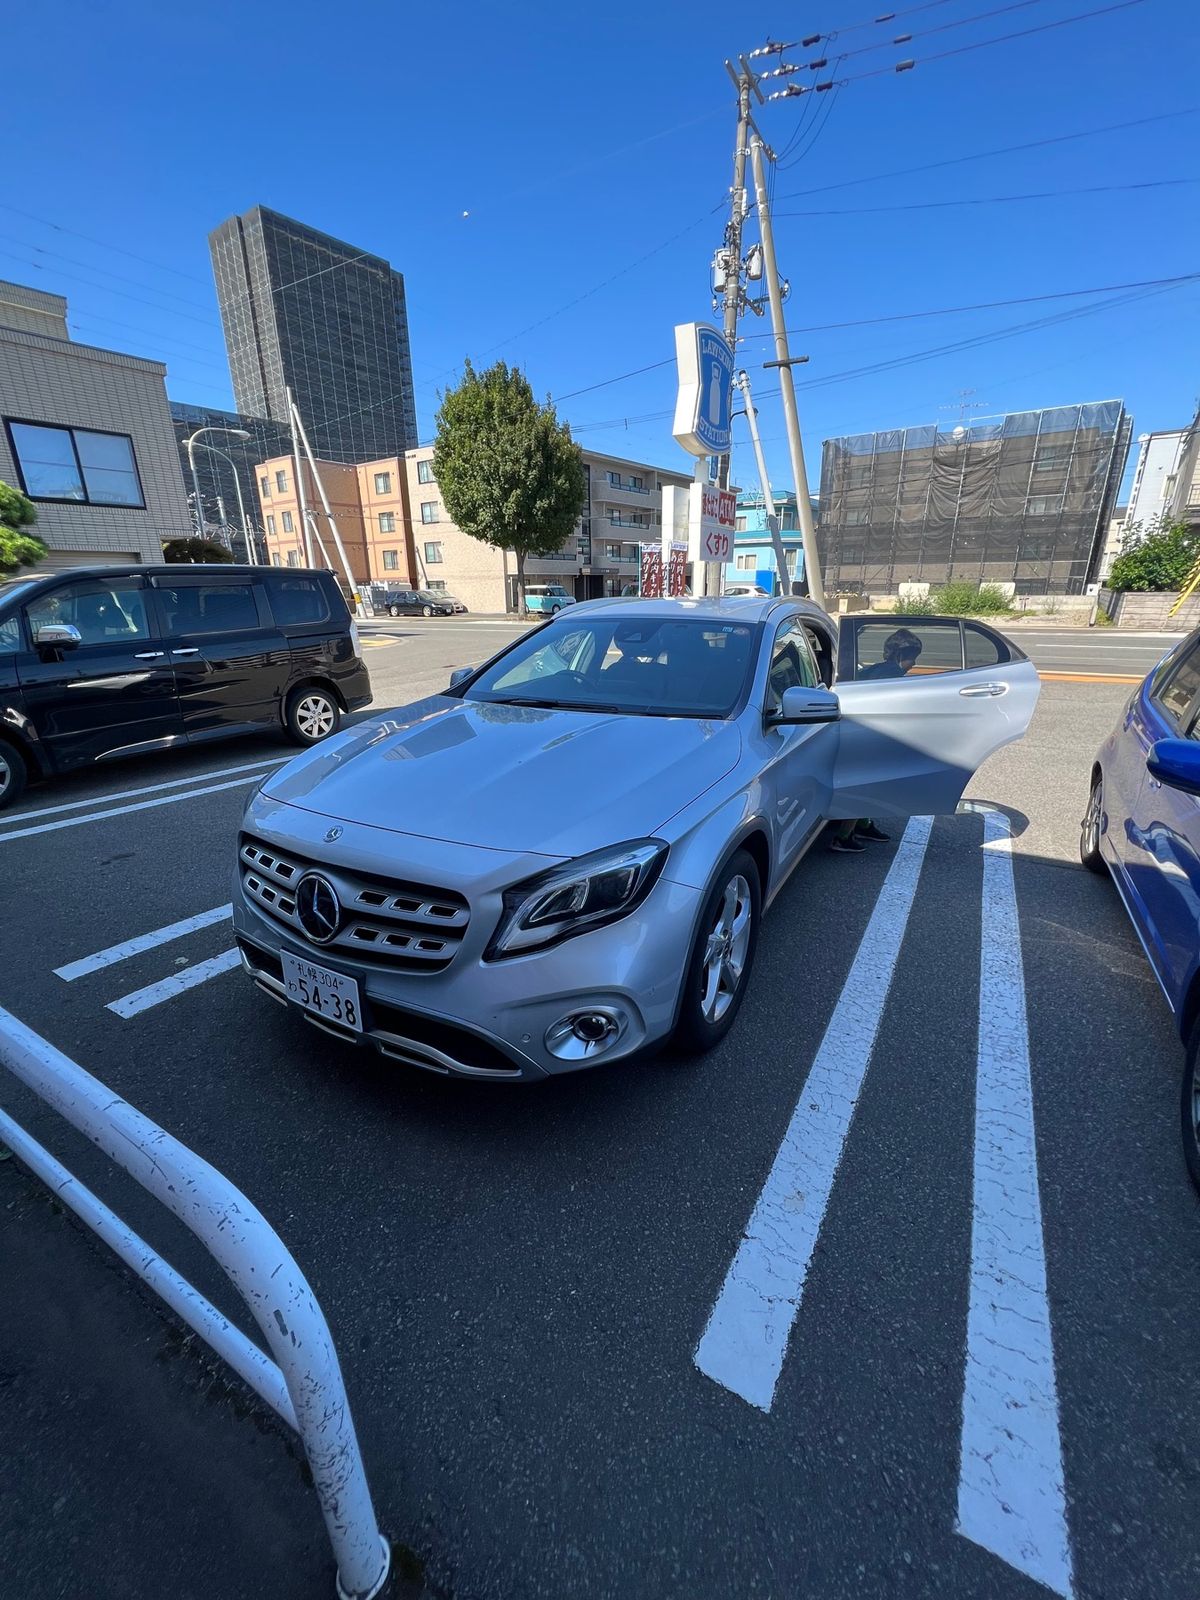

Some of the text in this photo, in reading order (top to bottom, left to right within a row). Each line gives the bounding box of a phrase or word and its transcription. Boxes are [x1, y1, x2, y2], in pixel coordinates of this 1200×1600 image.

[701, 338, 732, 374] LAWSON
[699, 416, 729, 443] STATION
[719, 498, 736, 522] ATM
[706, 532, 729, 557] くすり
[319, 971, 339, 990] 304
[298, 978, 357, 1026] 54-38
